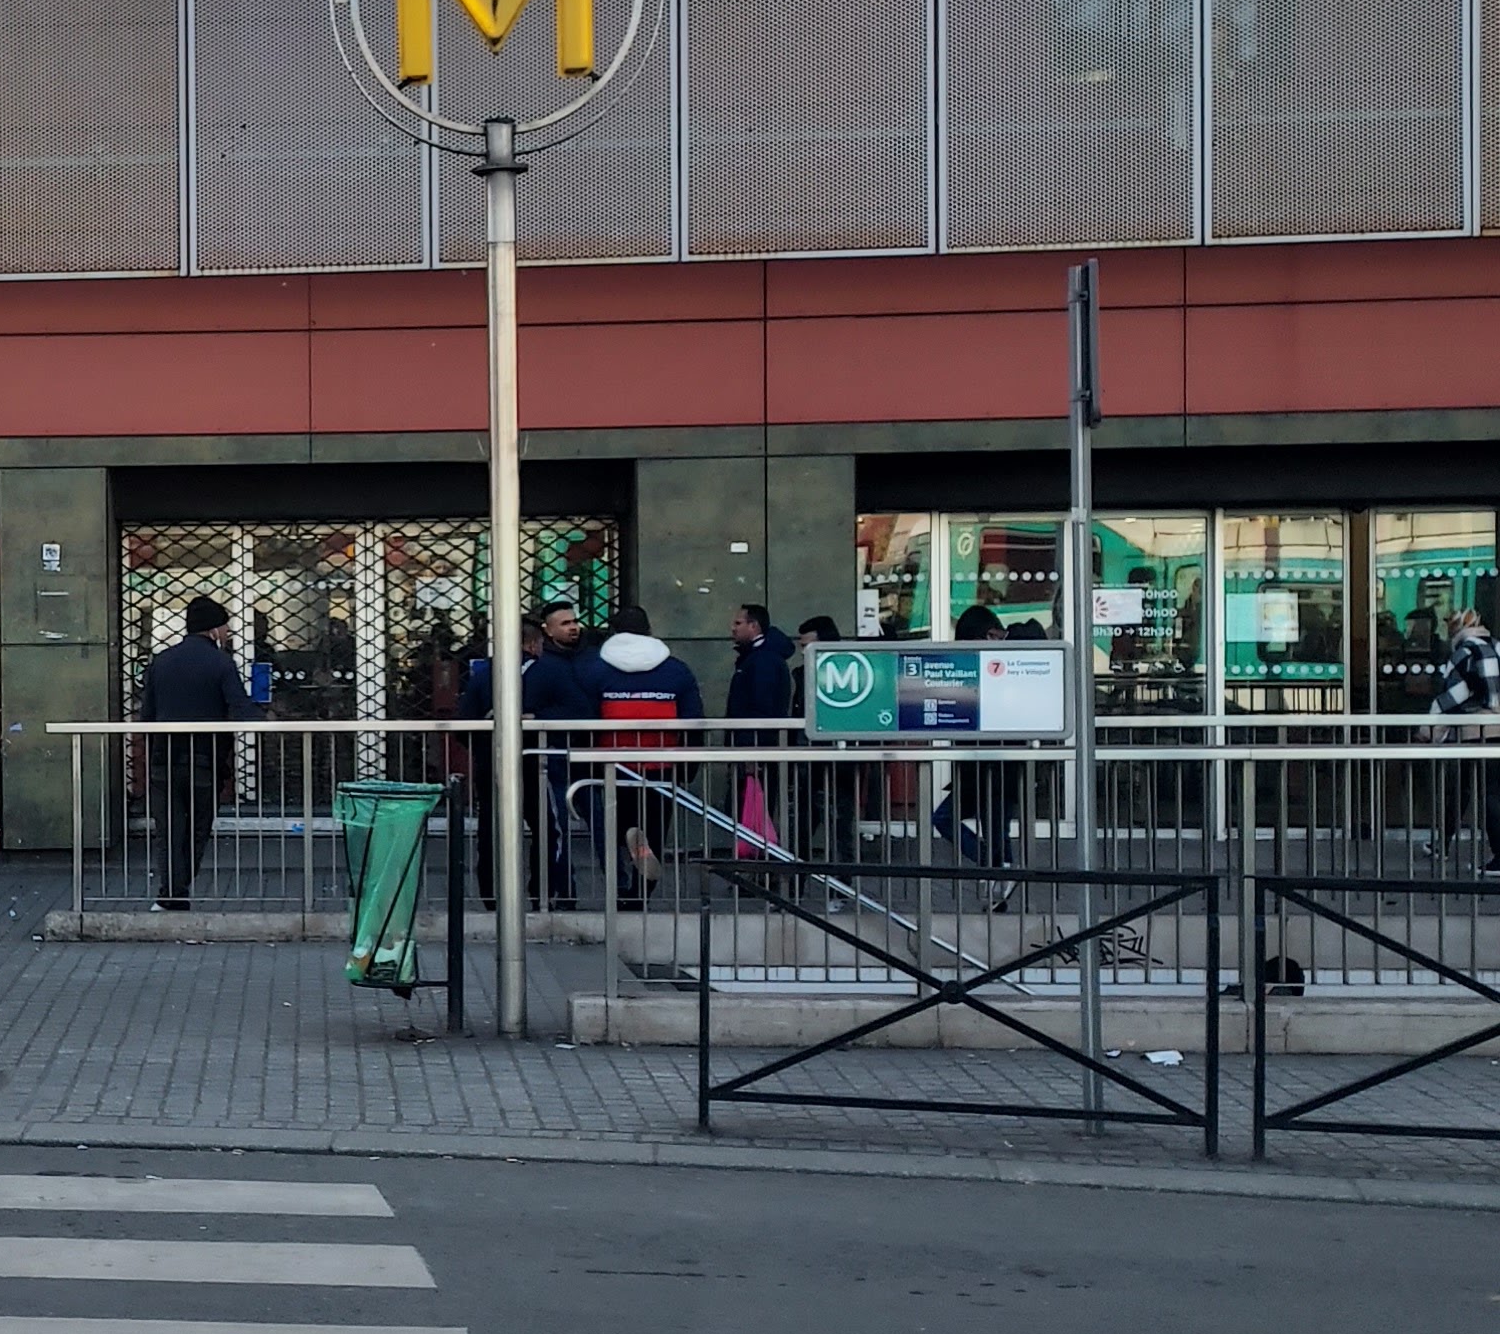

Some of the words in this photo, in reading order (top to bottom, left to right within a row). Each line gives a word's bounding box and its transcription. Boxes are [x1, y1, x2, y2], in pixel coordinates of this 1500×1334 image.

[1138, 627, 1174, 637] 12h30
[908, 663, 918, 676] 3
[924, 669, 943, 678] Paul
[945, 669, 977, 678] Vaillant
[991, 662, 1001, 674] 7
[826, 660, 859, 694] M
